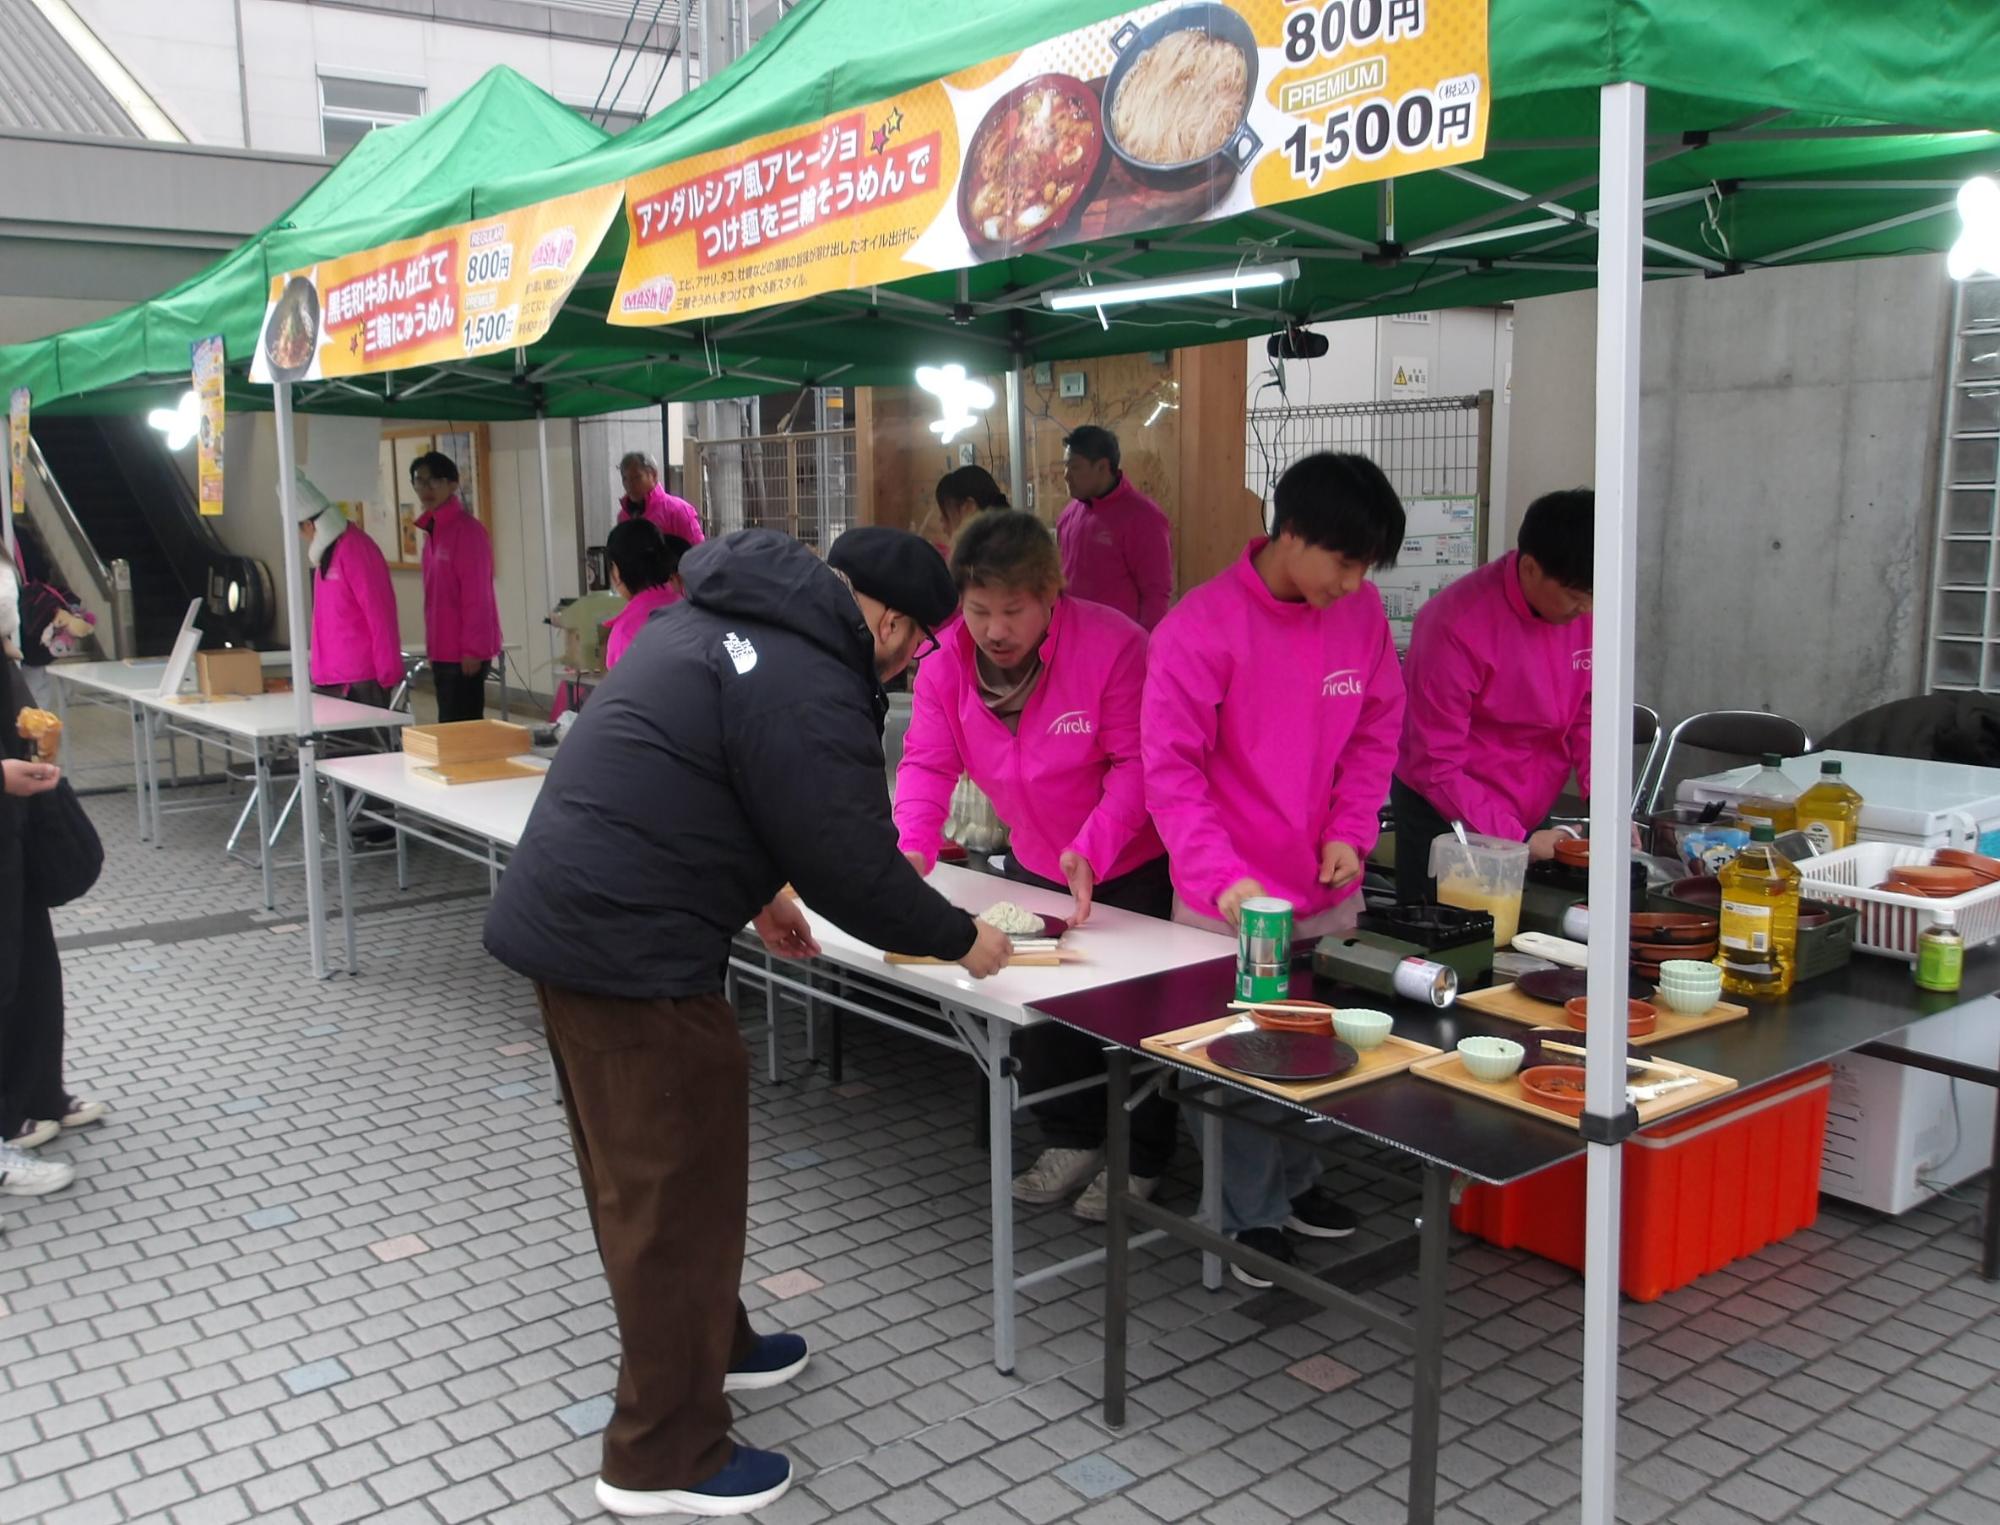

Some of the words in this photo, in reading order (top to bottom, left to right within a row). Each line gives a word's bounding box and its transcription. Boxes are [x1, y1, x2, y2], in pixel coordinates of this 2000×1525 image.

[1285, 0, 1420, 62] 800円
[1288, 63, 1379, 110] PREMIUM
[1285, 95, 1472, 182] 1,500円
[636, 126, 857, 238] アンダルシア風アヒージョ
[702, 144, 931, 258] つけ麺を三輪そうめんで
[327, 250, 449, 325] 黒毛和牛あん仕立て
[466, 249, 511, 284] 800円
[658, 282, 674, 311] UP
[365, 295, 455, 352] 三輪にゅうめん
